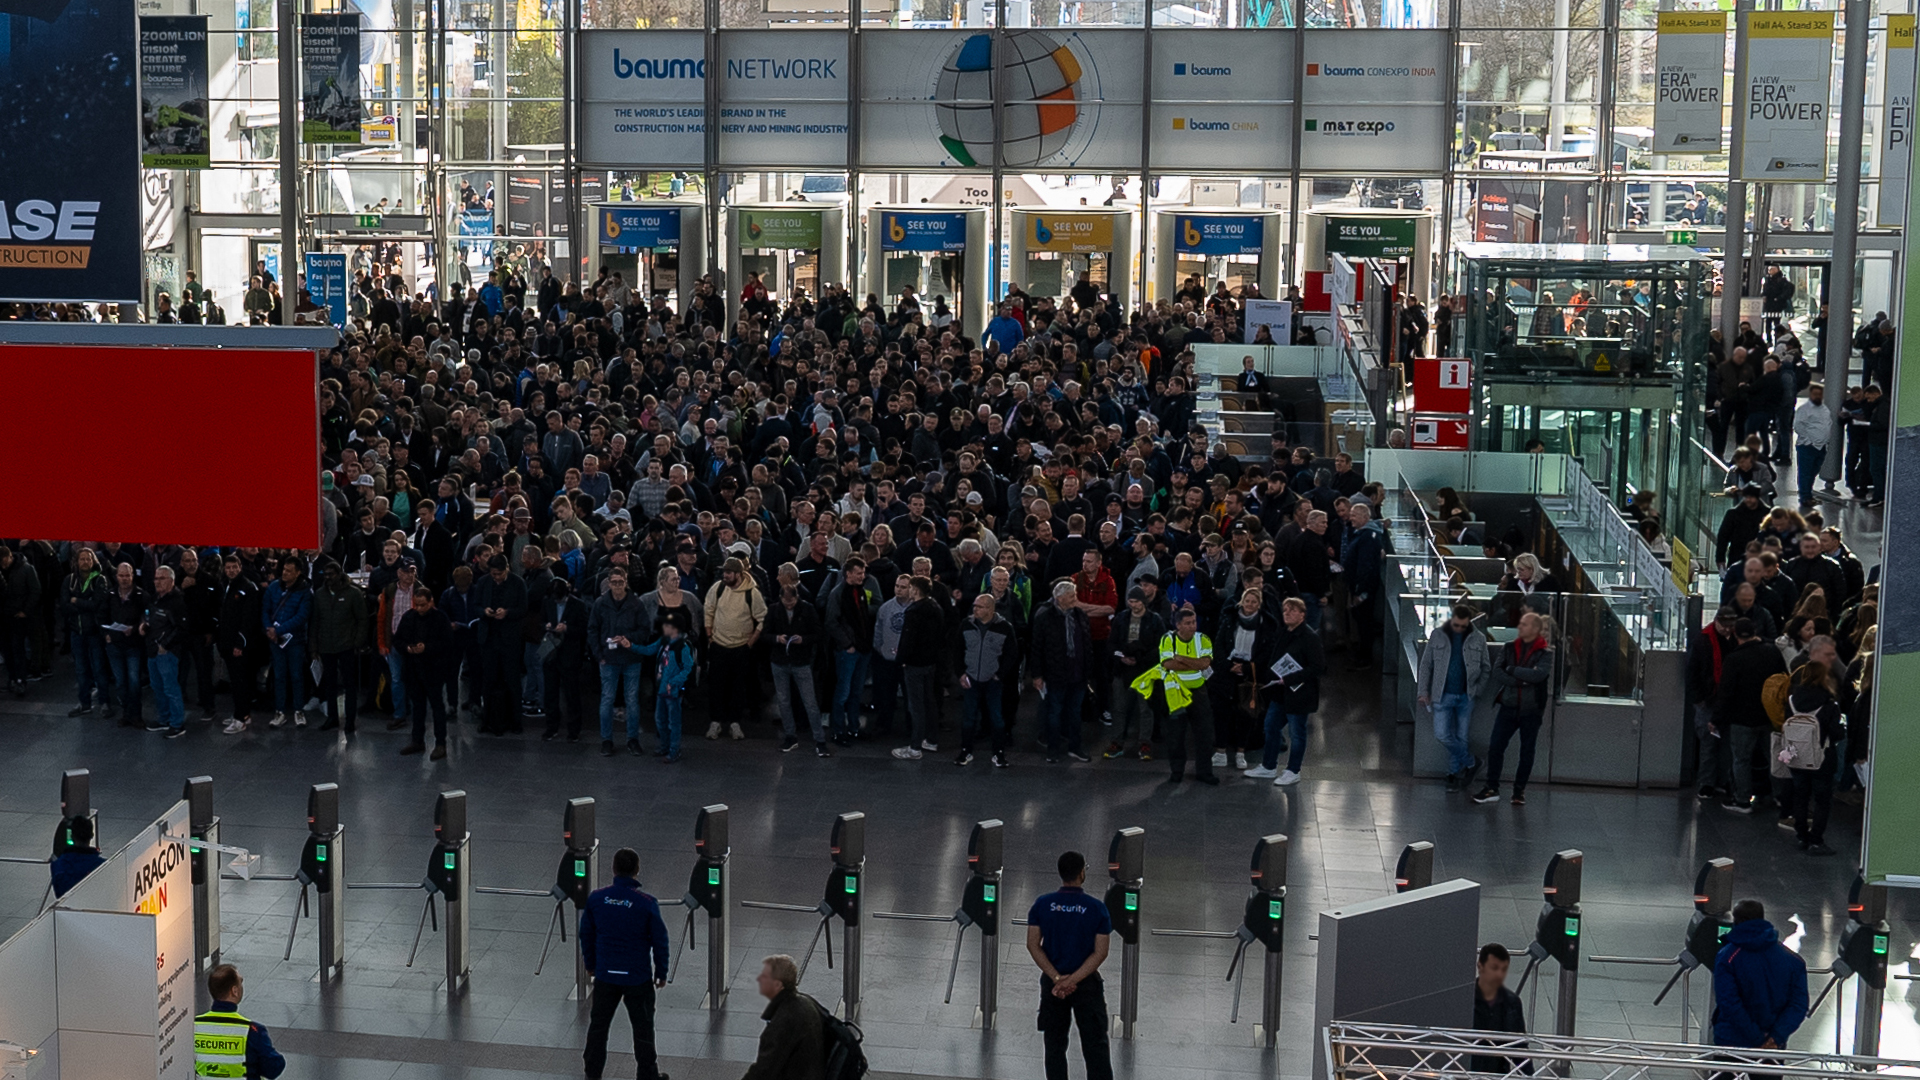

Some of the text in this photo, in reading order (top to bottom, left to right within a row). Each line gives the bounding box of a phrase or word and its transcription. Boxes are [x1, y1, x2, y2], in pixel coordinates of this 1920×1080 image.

[1676, 20, 1688, 28] A4,
[1754, 21, 1827, 30] Hall A4, Stand 325
[303, 26, 358, 35] ZOOMLION
[141, 32, 206, 41] ZOOMLION
[142, 46, 178, 54] VISION
[142, 65, 182, 73] FUTURE
[727, 59, 837, 79] NETWORK
[1191, 63, 1231, 75] bauma
[1324, 64, 1436, 76] bauma CONEXPO INDIA
[1660, 73, 1690, 87] ERA
[1660, 88, 1718, 102] POWER
[1751, 85, 1788, 101] ERA
[1892, 96, 1899, 105] A
[614, 109, 632, 118] THE
[634, 109, 675, 118] WORLD'S
[721, 110, 754, 118] BRAND
[756, 110, 766, 118] IN
[768, 110, 786, 118] THE
[1750, 103, 1822, 120] POWER
[614, 124, 684, 133] CONSTRUCTION
[748, 124, 766, 133] AND
[768, 125, 801, 133] MINING
[804, 125, 848, 133] INDUSTRY
[1190, 118, 1260, 130] bauma CHINA
[1483, 159, 1539, 171] DEVELON
[1548, 160, 1590, 171] DEVELON
[965, 188, 988, 197] Too
[1482, 194, 1507, 203] Achieve
[1482, 203, 1509, 212] the Next
[622, 217, 660, 226] SEE YOU
[764, 219, 802, 227] SEE YOU
[907, 221, 946, 230] SEE YOU
[1054, 222, 1093, 231] SEE YOU
[1204, 224, 1244, 234] SEE YOU
[1340, 226, 1380, 236] SEE YOU
[1240, 245, 1261, 253] bauma
[0, 248, 83, 264] RUCTION
[310, 256, 342, 267] bauma
[134, 834, 184, 903] ARAGON
[604, 896, 633, 908] Security
[1050, 902, 1087, 914] Security
[194, 1040, 240, 1050] SECURITY
